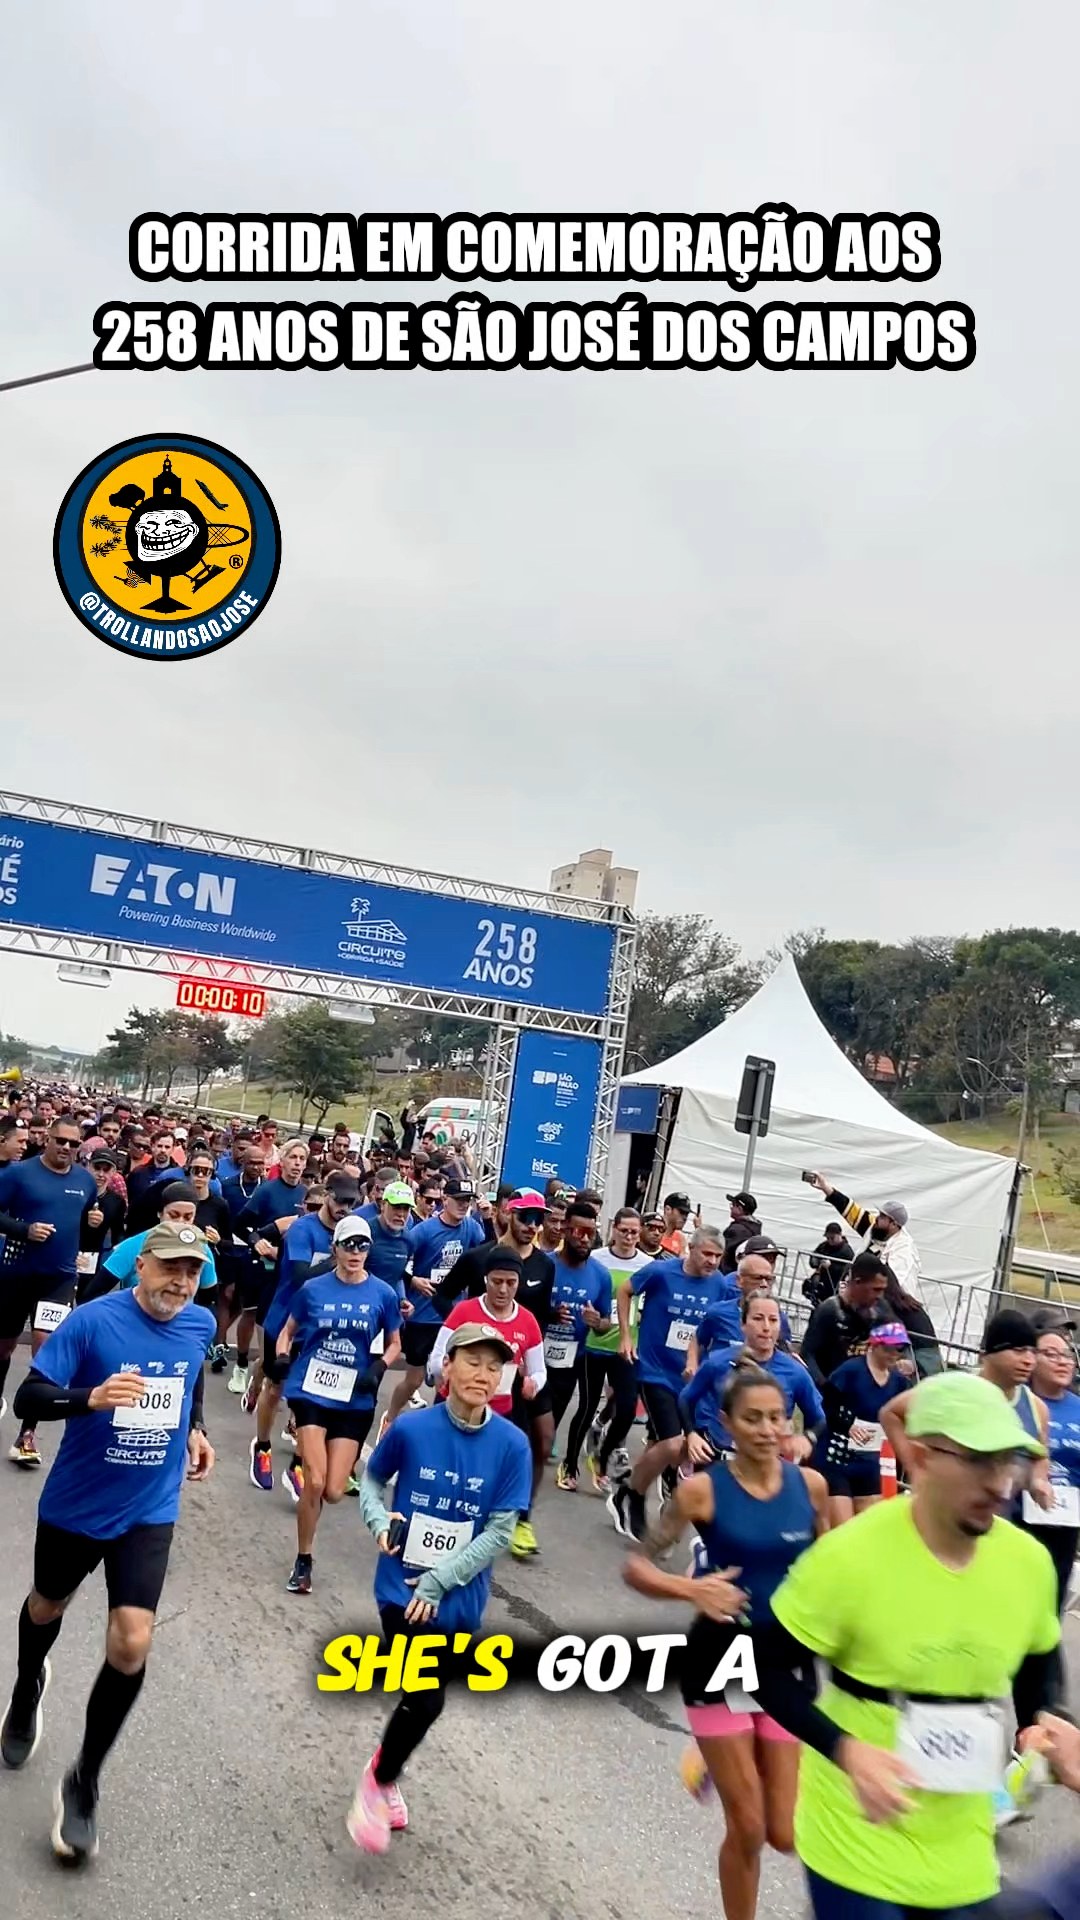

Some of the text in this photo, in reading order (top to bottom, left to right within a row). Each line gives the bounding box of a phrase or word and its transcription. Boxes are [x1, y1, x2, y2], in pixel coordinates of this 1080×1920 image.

[90, 853, 237, 916] EATON
[118, 905, 278, 943] Powering Business Worldwide
[337, 941, 406, 961] CIRCUITO
[474, 919, 538, 964] 258
[462, 958, 535, 989] ANOS
[180, 982, 263, 1015] 00:00:10
[314, 1369, 340, 1389] 2400
[106, 1447, 167, 1460] CIRCUITO
[422, 1531, 457, 1551] 860
